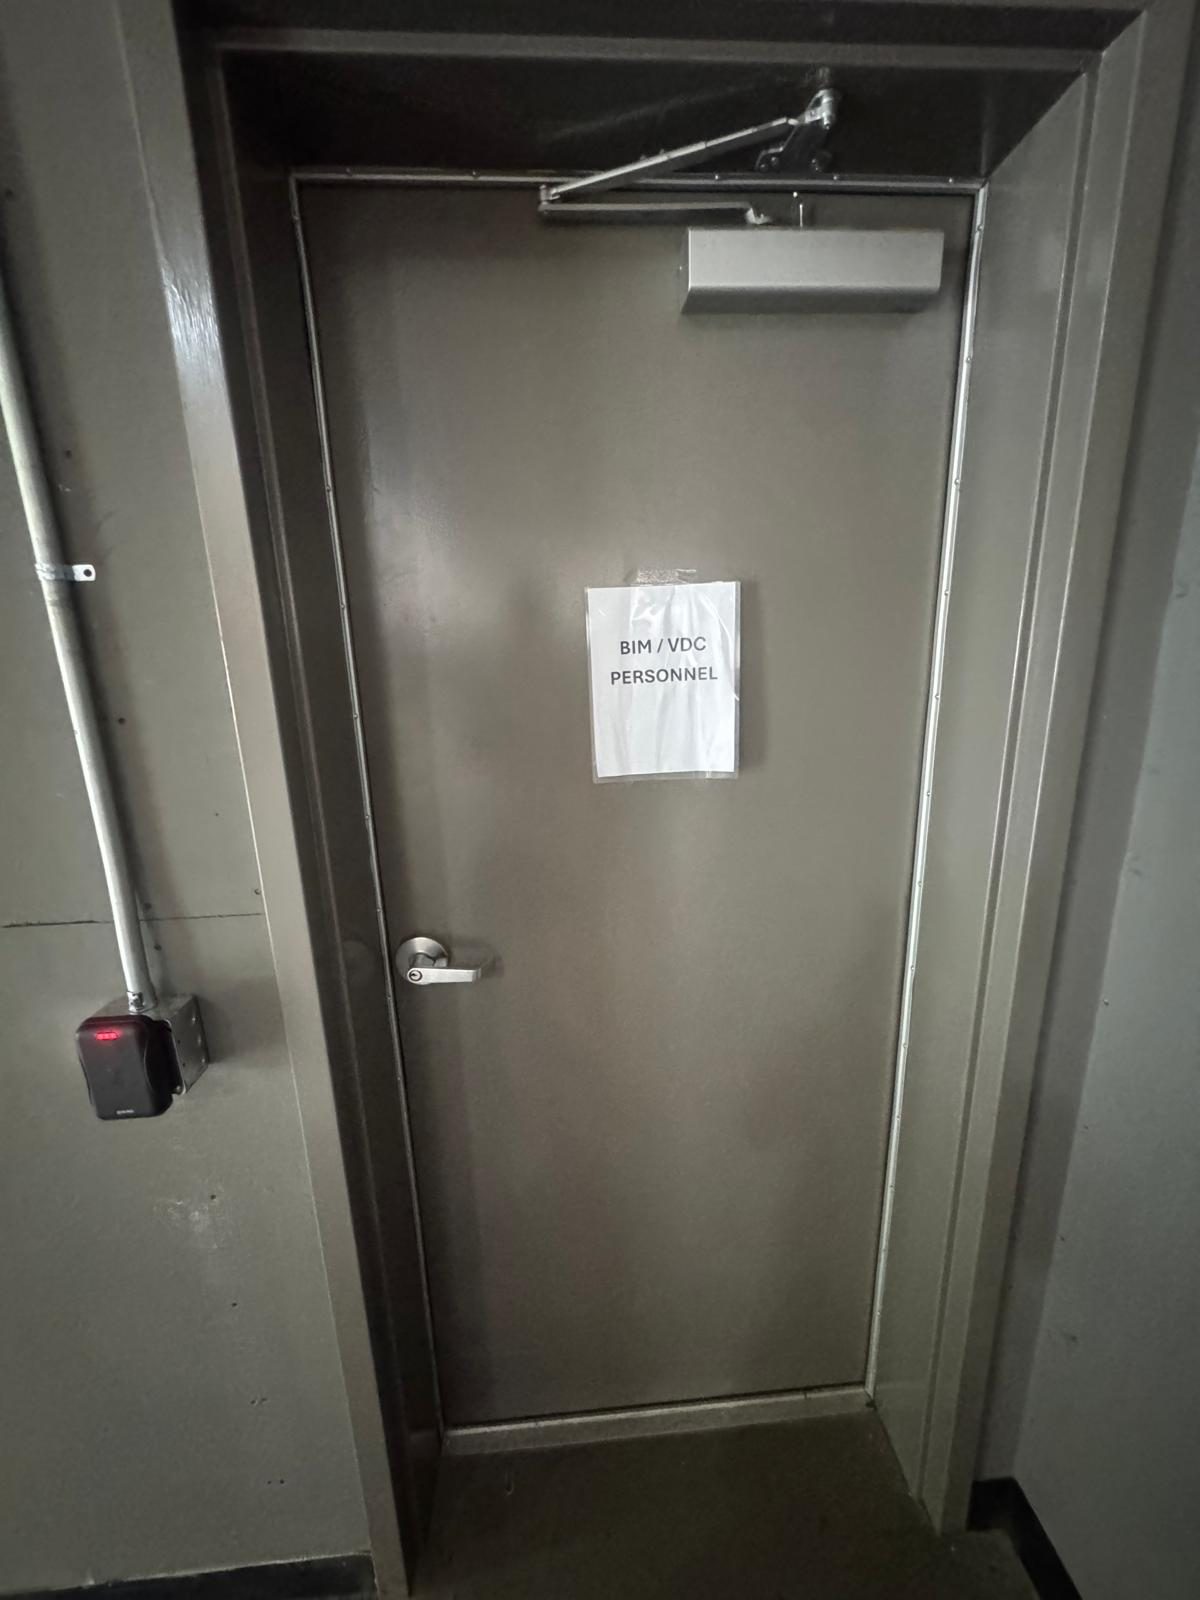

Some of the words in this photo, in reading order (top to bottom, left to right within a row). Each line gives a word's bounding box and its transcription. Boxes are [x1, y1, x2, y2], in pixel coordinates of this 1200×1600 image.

[620, 639, 652, 655] BIM
[657, 638, 664, 654] /
[668, 636, 707, 653] VDC
[611, 666, 718, 685] PERSONNEL
